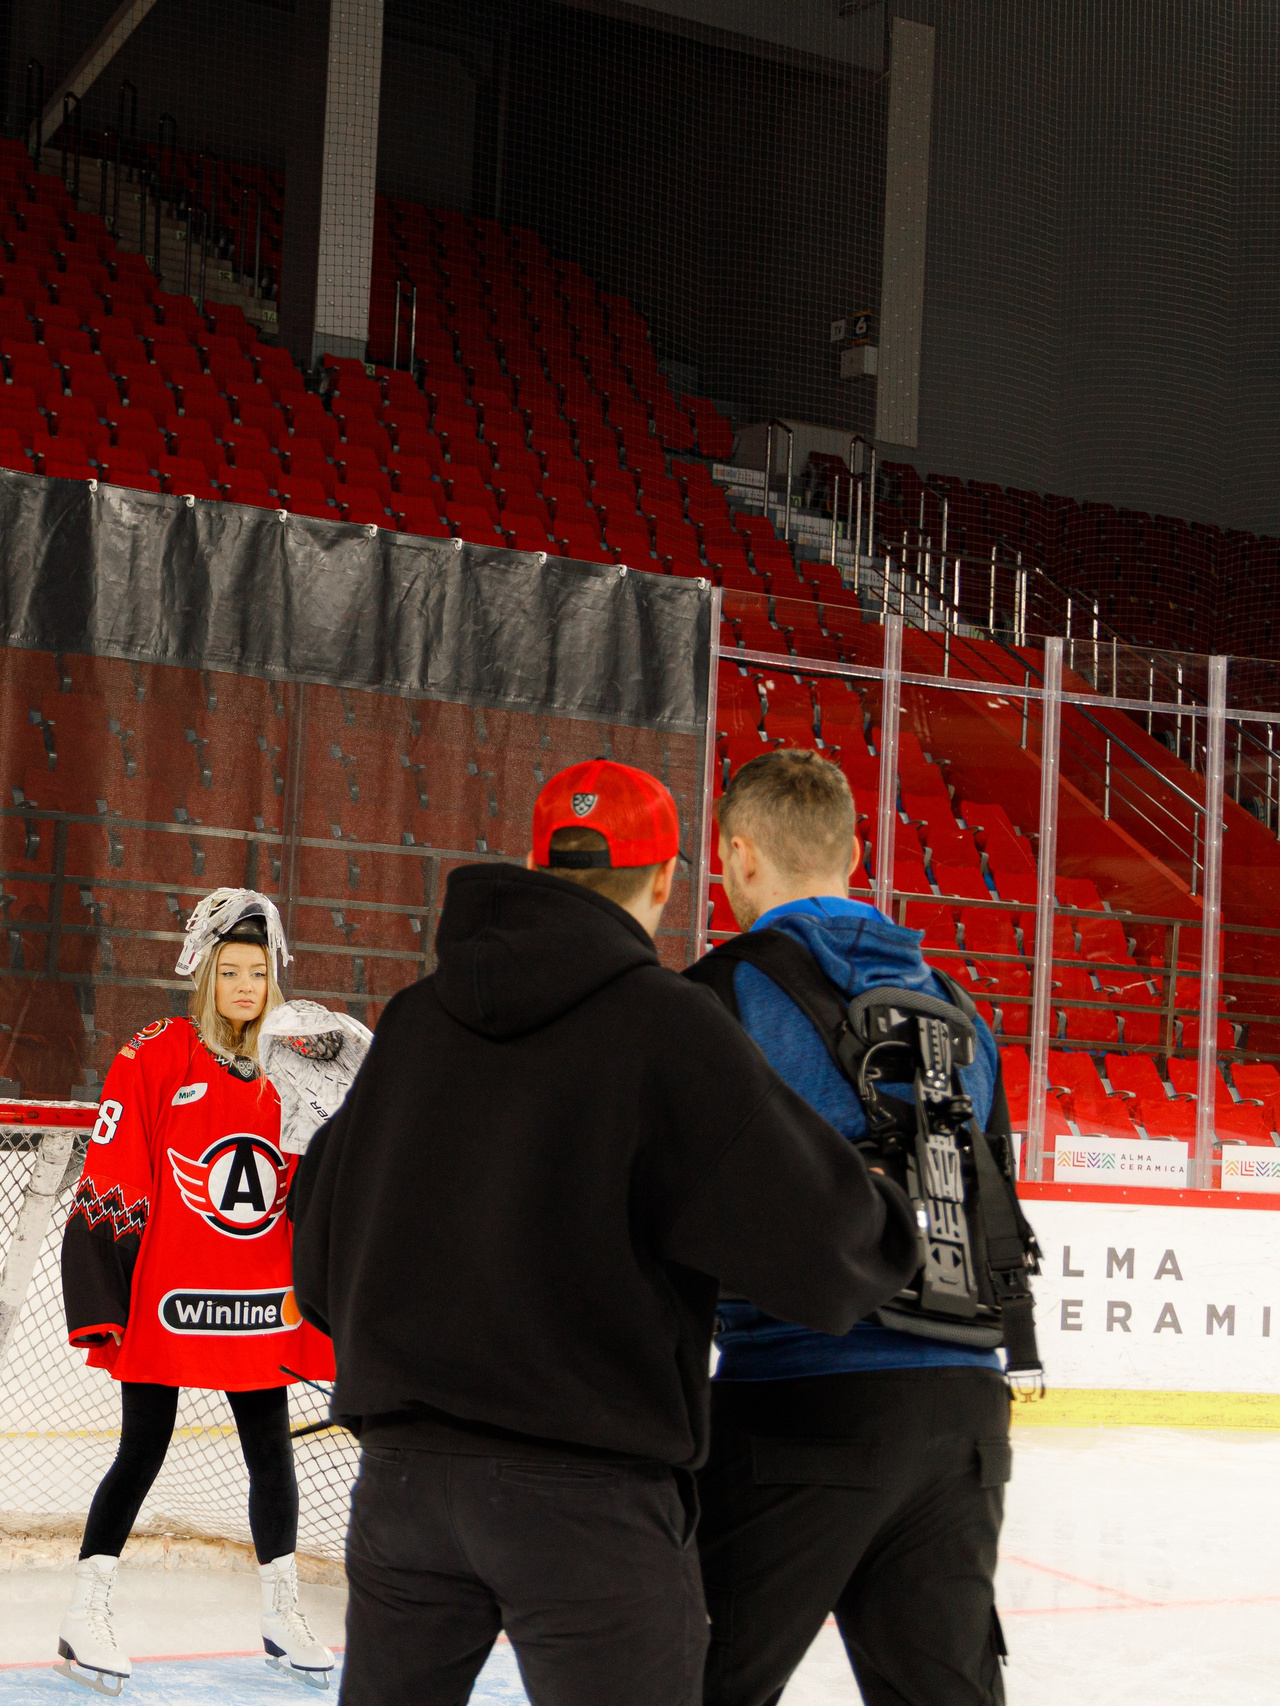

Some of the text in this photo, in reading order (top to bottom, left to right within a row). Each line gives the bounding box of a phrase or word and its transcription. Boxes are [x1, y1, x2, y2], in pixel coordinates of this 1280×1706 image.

[1120, 1153, 1153, 1162] ALMA
[1120, 1163, 1186, 1174] CERAMICA
[1063, 1246, 1184, 1282] LMA
[174, 1298, 277, 1324] Winline
[1061, 1299, 1271, 1338] ERAMI
